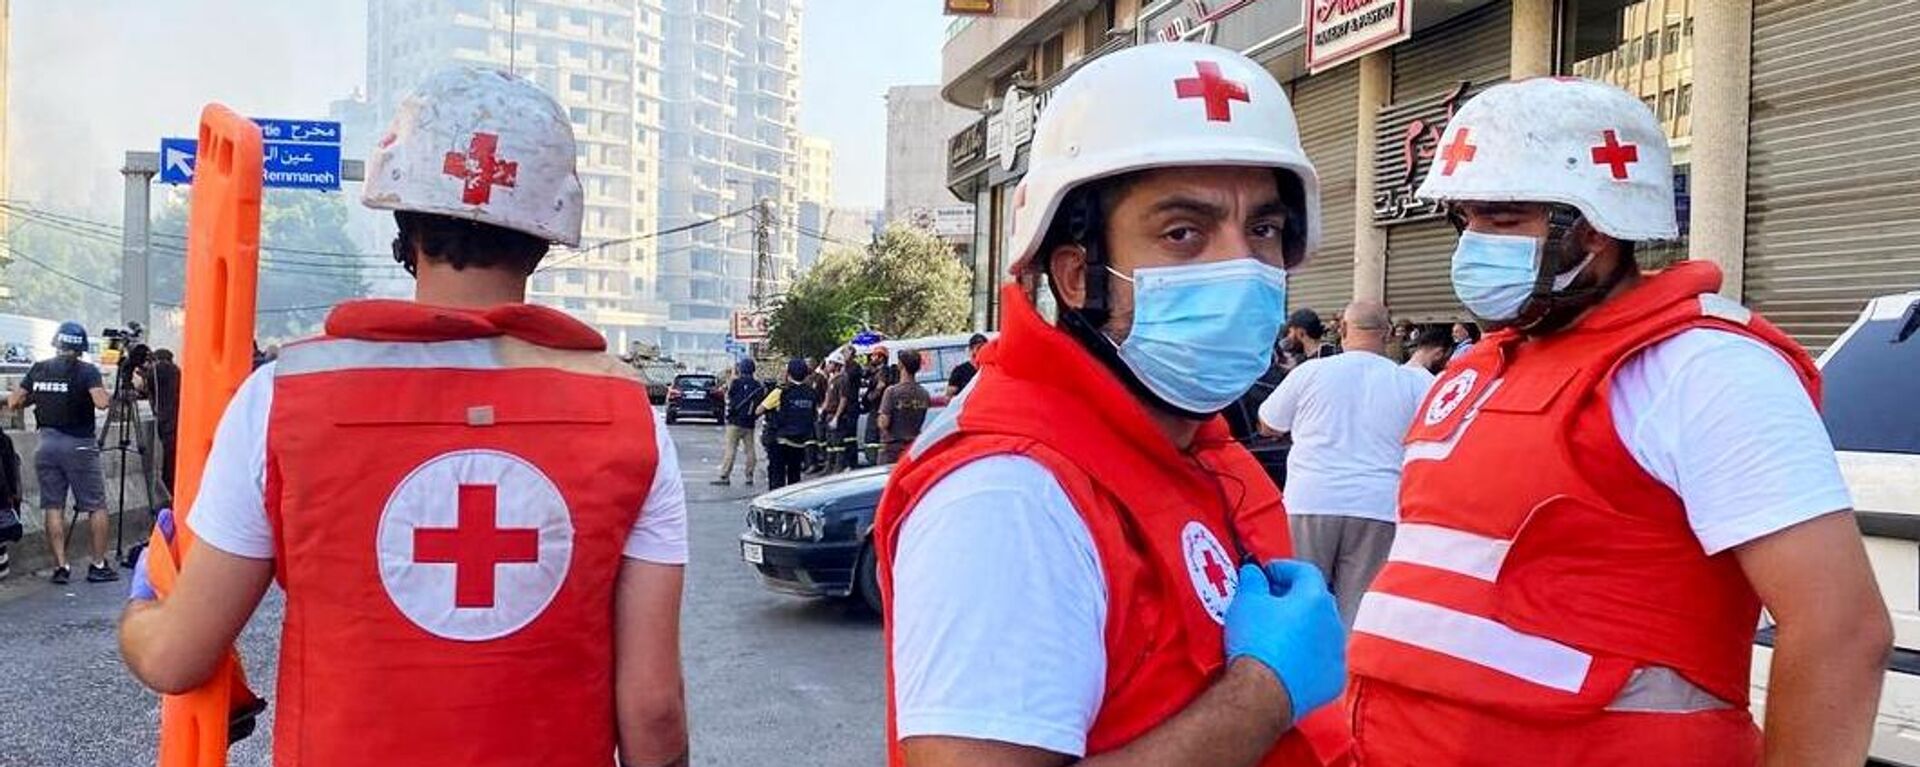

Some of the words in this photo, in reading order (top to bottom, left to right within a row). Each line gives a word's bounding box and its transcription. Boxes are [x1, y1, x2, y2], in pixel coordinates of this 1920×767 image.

[291, 124, 336, 138] مخرج
[281, 150, 314, 167] عين
[57, 333, 83, 344] PRESS
[32, 381, 69, 392] PRESS
